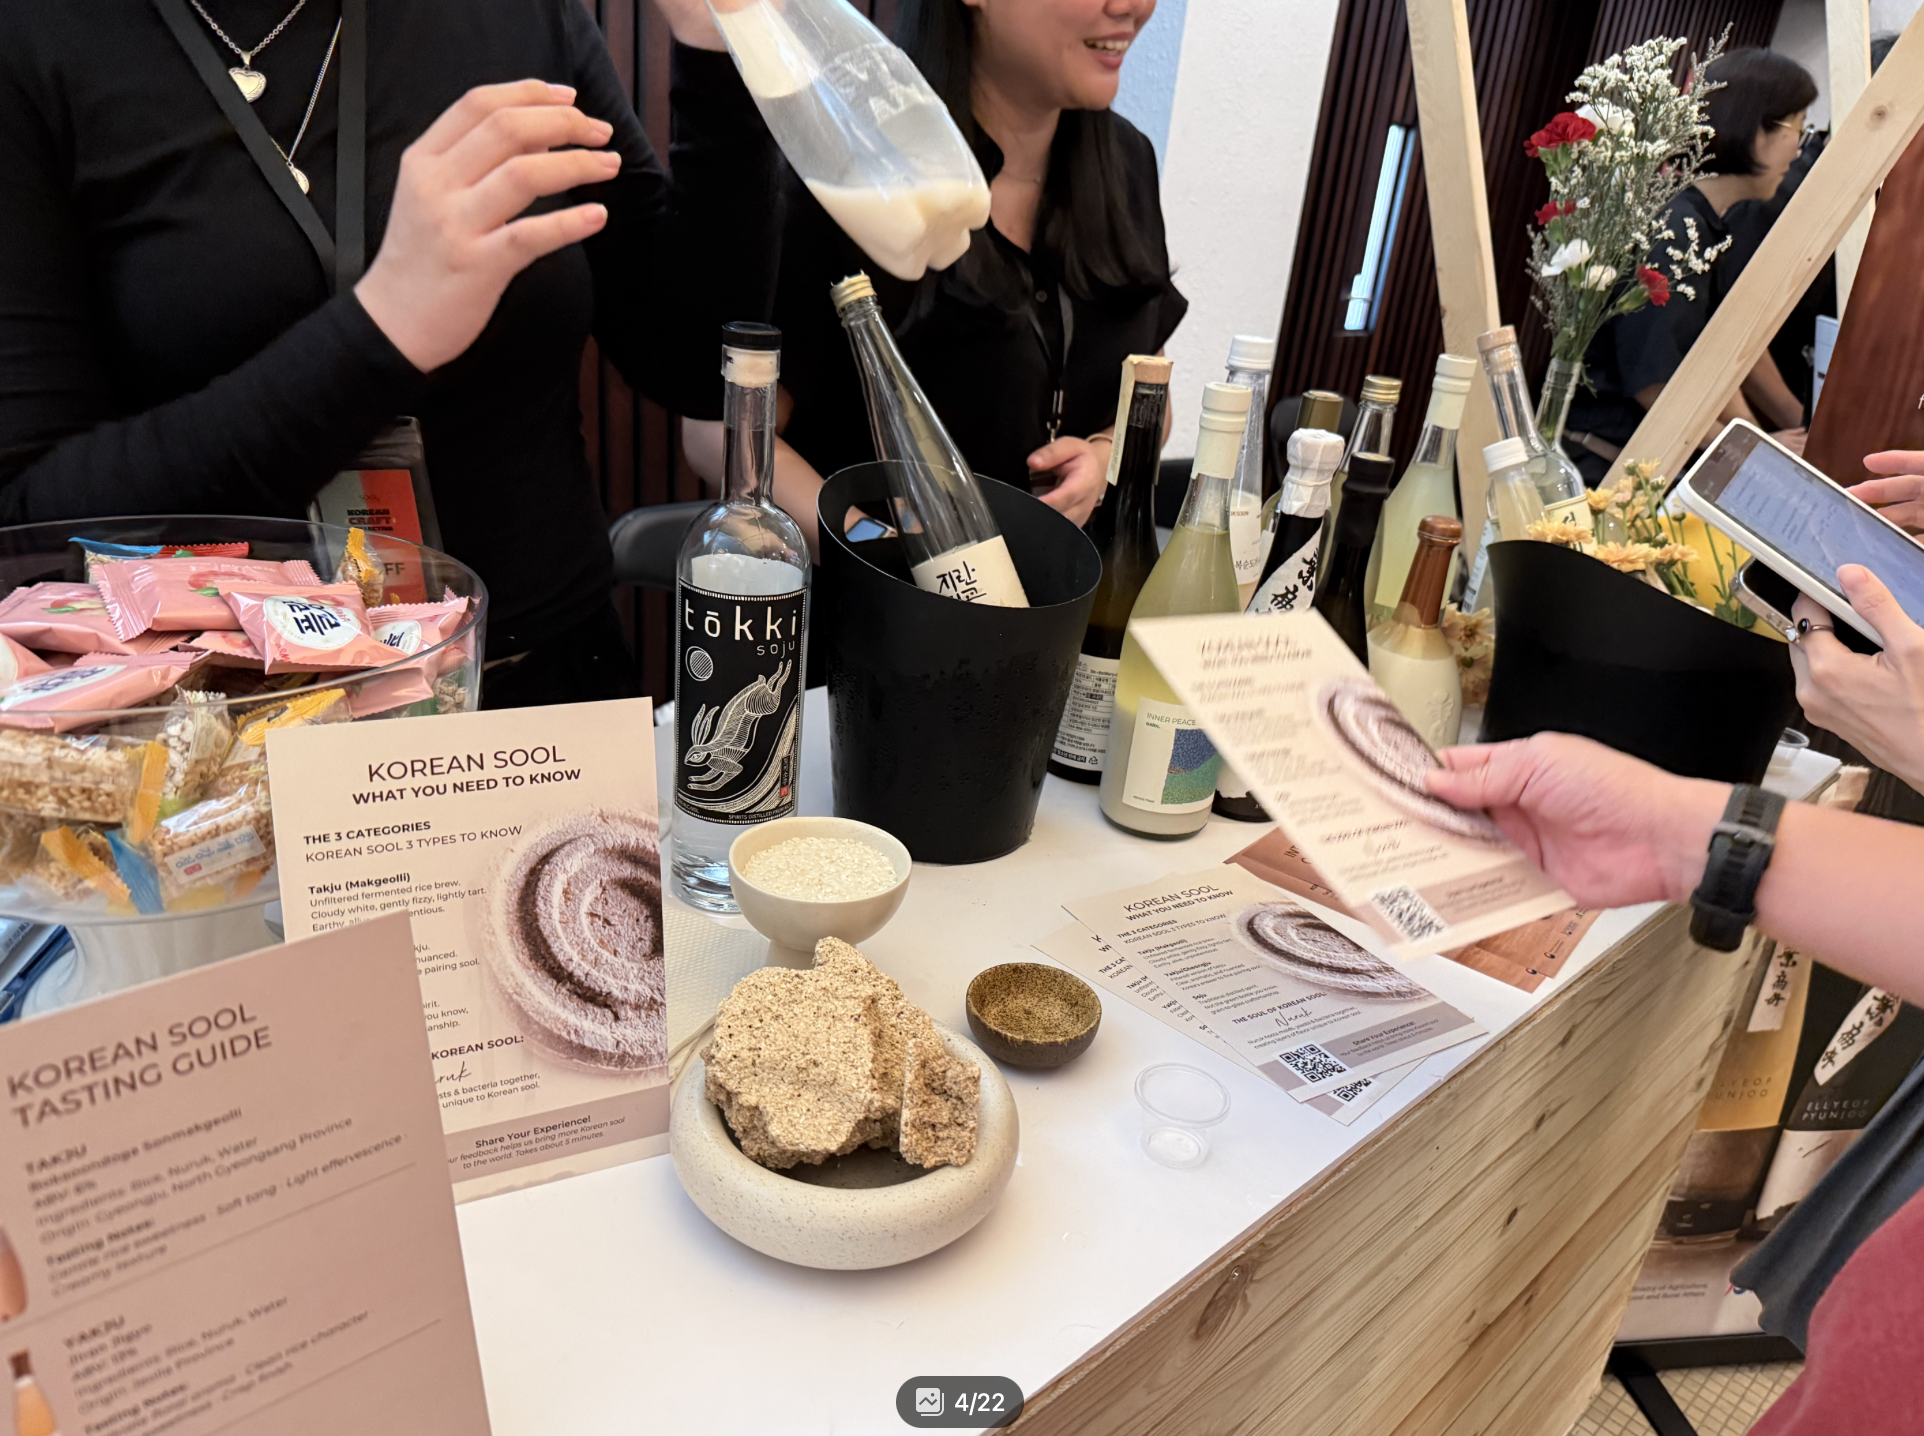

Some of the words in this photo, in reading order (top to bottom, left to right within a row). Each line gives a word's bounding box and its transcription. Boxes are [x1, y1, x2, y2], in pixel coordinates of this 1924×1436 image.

[348, 517, 391, 525] CRAFT
[384, 562, 405, 574] FF
[936, 561, 978, 593] 지란
[756, 641, 795, 658] soju
[1146, 712, 1170, 723] INNER
[1172, 718, 1196, 726] PEACE
[368, 752, 484, 782] KOREAN
[493, 744, 566, 769] SOOL
[352, 788, 407, 805] WHAT
[410, 784, 447, 798] YOU
[453, 778, 498, 793] NEED
[502, 775, 525, 787] TO
[529, 768, 581, 784] KNOW
[303, 834, 331, 845] THE
[334, 832, 342, 841] 3
[346, 821, 431, 840] CATEGORIES
[305, 846, 363, 862] KOREAN
[366, 841, 403, 854] SOOL
[406, 840, 413, 849] 3
[416, 834, 457, 847] TYPES
[459, 831, 477, 842] TO
[480, 825, 522, 839] KNOW
[309, 883, 341, 894] Takju
[345, 873, 410, 892] (Makgeolli)
[309, 892, 359, 907] Unfiltered
[361, 885, 412, 899] fermented
[414, 883, 433, 892] rice
[434, 880, 461, 889] brew.
[311, 907, 345, 919] Cloudy
[347, 903, 377, 914] white,
[379, 897, 410, 911] gently
[412, 895, 434, 904] fizzy,
[437, 889, 466, 901] lightly
[468, 885, 487, 895] tart.
[1124, 894, 1181, 912] KOREAN
[1181, 884, 1219, 898] SOOL
[1126, 911, 1152, 921] WHAT
[1153, 906, 1171, 914] YOU
[1172, 900, 1195, 909] NEED
[1207, 890, 1233, 899] KNOW
[409, 906, 444, 917] entious.
[1137, 919, 1178, 933] CATEGORIES
[414, 942, 430, 952] kju.
[425, 963, 457, 975] pairing
[459, 958, 480, 968] sool.
[1232, 1016, 1248, 1025] THE
[1248, 1010, 1268, 1019] SOUL
[1277, 998, 1306, 1010] KOREAN
[1306, 991, 1327, 1001] SOOL:
[1275, 1007, 1312, 1026] Nuruk
[428, 1019, 460, 1031] anship.
[7, 1032, 159, 1098] KOREAN
[168, 1003, 257, 1047] SOOL
[431, 1042, 483, 1060] KOREAN
[487, 1035, 524, 1049] SOOL:
[13, 1063, 163, 1128] TASTING
[172, 1025, 272, 1076] GUIDE
[435, 1061, 472, 1084] ruk
[1720, 1077, 1772, 1087] LYEOP
[438, 1089, 451, 1099] sts
[442, 1096, 473, 1108] unique
[476, 1093, 485, 1101] to
[488, 1087, 518, 1099] Korean
[520, 1081, 540, 1092] sool.
[1708, 1088, 1769, 1100] UNJOO
[460, 1146, 498, 1161] feedback
[500, 1142, 521, 1152] helps
[535, 1134, 556, 1144] bring
[558, 1129, 578, 1138] more
[580, 1122, 608, 1133] Korean
[610, 1116, 625, 1126] sool
[475, 1137, 504, 1148] Share
[508, 1131, 530, 1141] Your
[533, 1115, 591, 1135] Experience!
[286, 1167, 319, 1189] Light
[321, 1134, 402, 1174] effervescence
[473, 1158, 487, 1167] the
[489, 1152, 513, 1163] world.
[516, 1147, 538, 1157] Takes
[540, 1140, 563, 1152] about
[565, 1138, 570, 1146] 5
[572, 1132, 604, 1144] minutes.
[1633, 1284, 1656, 1292] inistry
